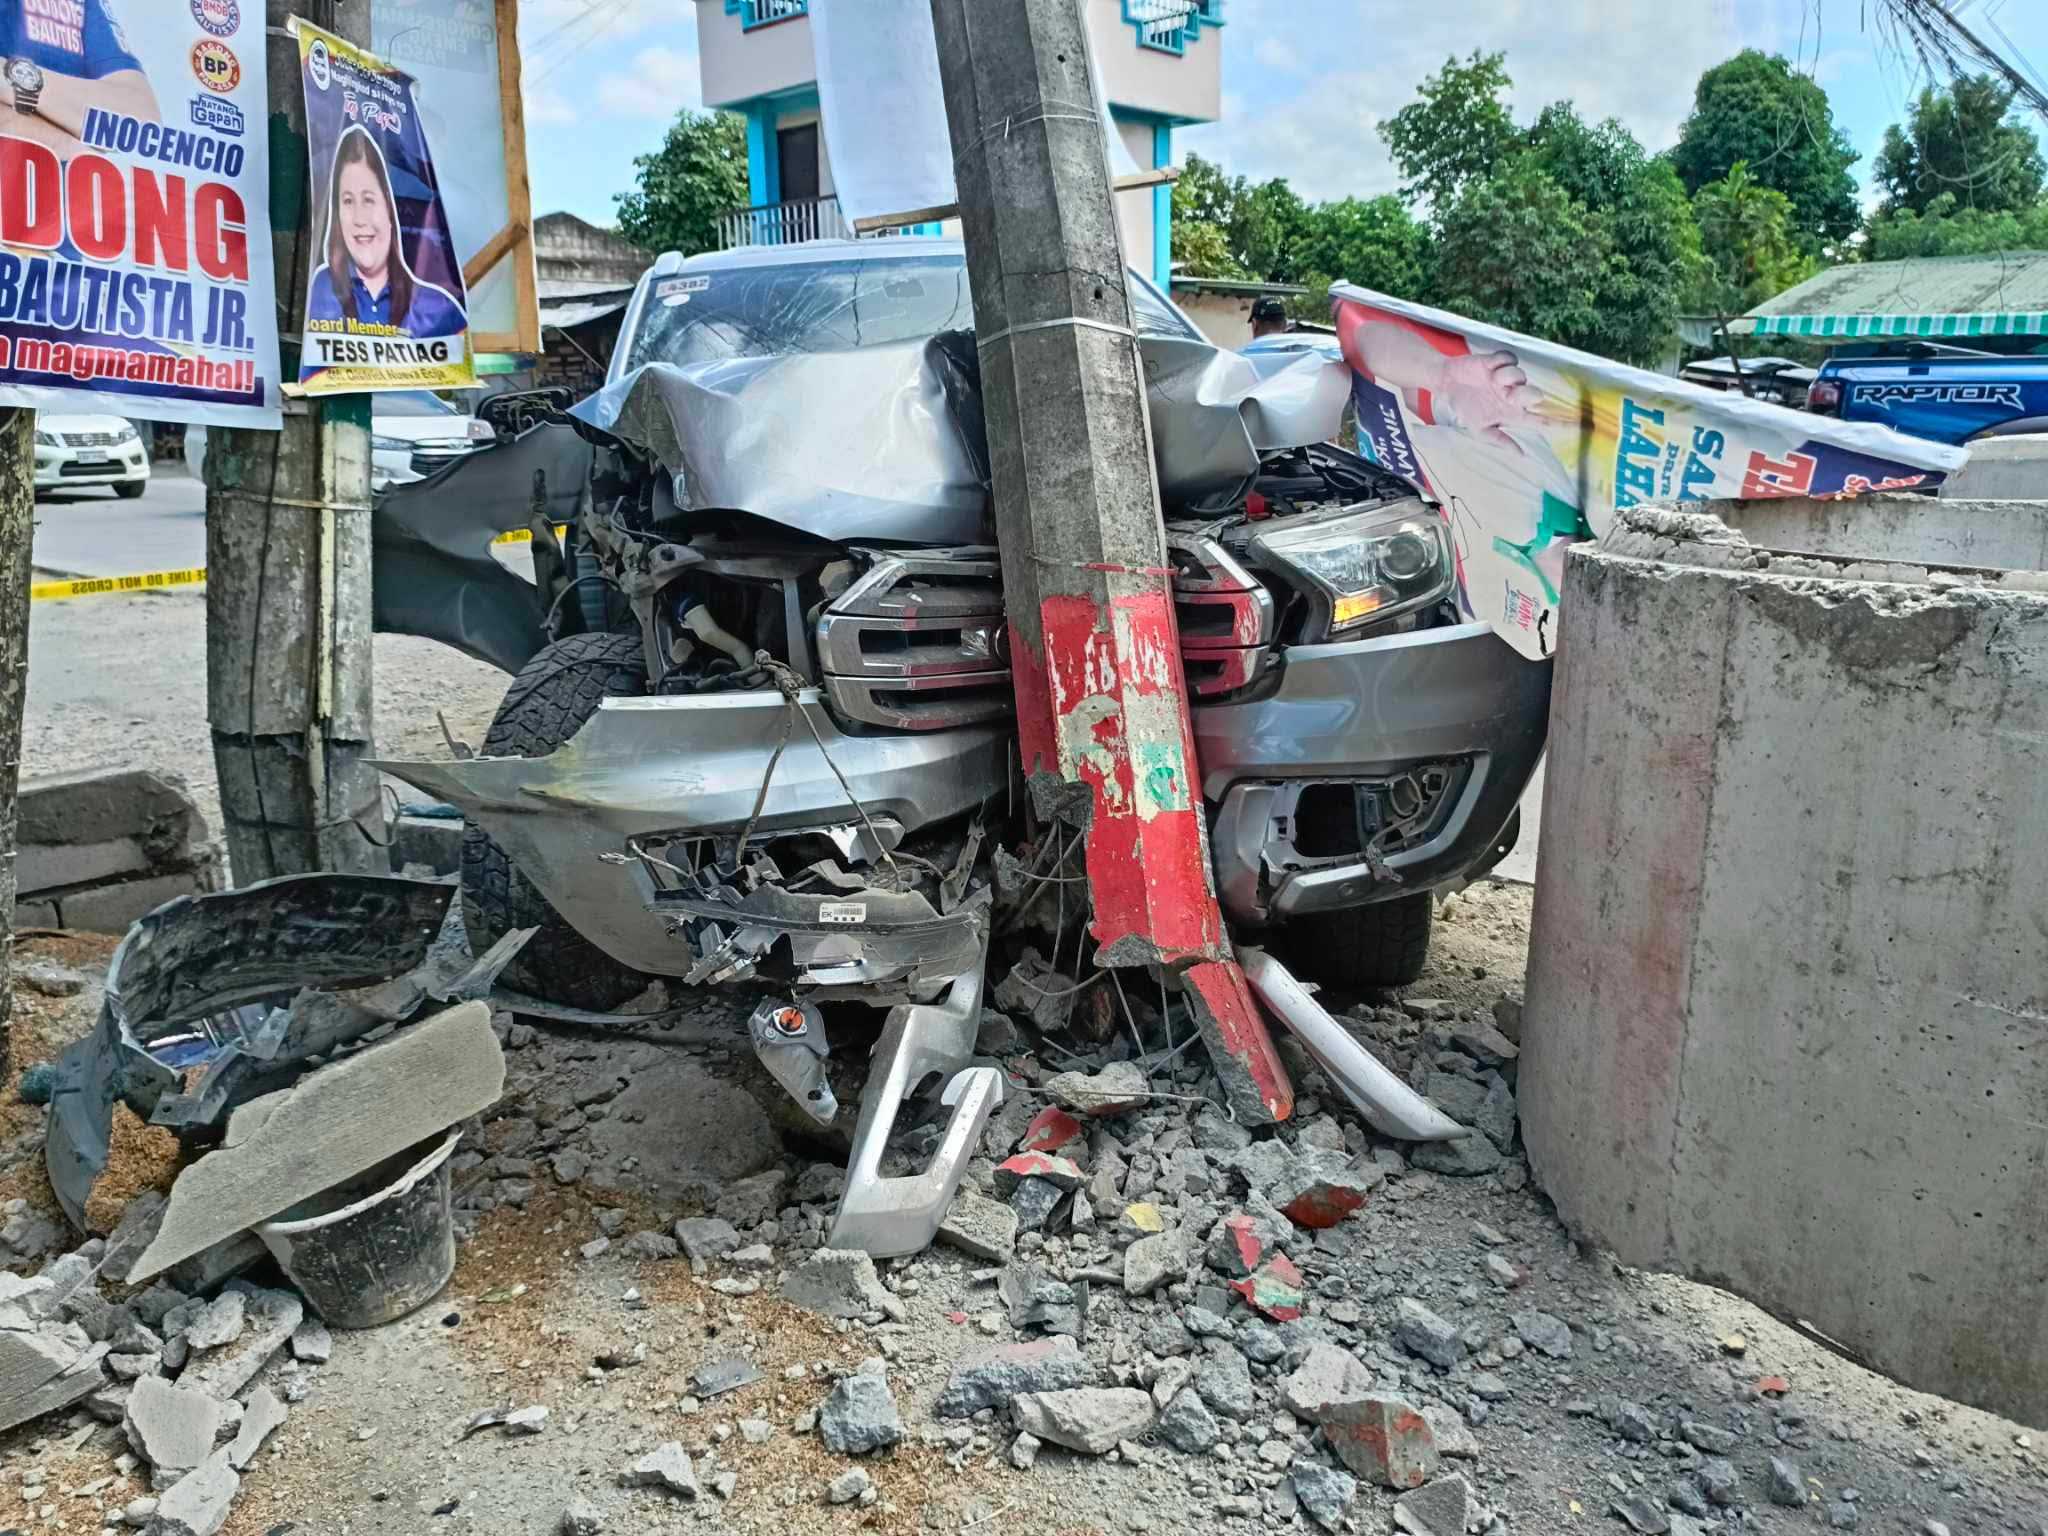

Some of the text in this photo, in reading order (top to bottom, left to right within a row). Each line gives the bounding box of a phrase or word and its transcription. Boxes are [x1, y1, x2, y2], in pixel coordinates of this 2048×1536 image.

[204, 55, 228, 75] BP
[201, 99, 235, 115] BATANG
[83, 108, 245, 178] INOCENCIO
[0, 135, 249, 281] DONG
[0, 252, 255, 350] BAUTISTA JR.
[310, 316, 398, 337] oard Member
[15, 337, 255, 393] magmamahal!
[316, 338, 449, 363] TESS PATIAG
[1853, 383, 2026, 412] RAPTOR
[1379, 403, 1416, 481] JIMMY
[1660, 441, 1680, 497] para
